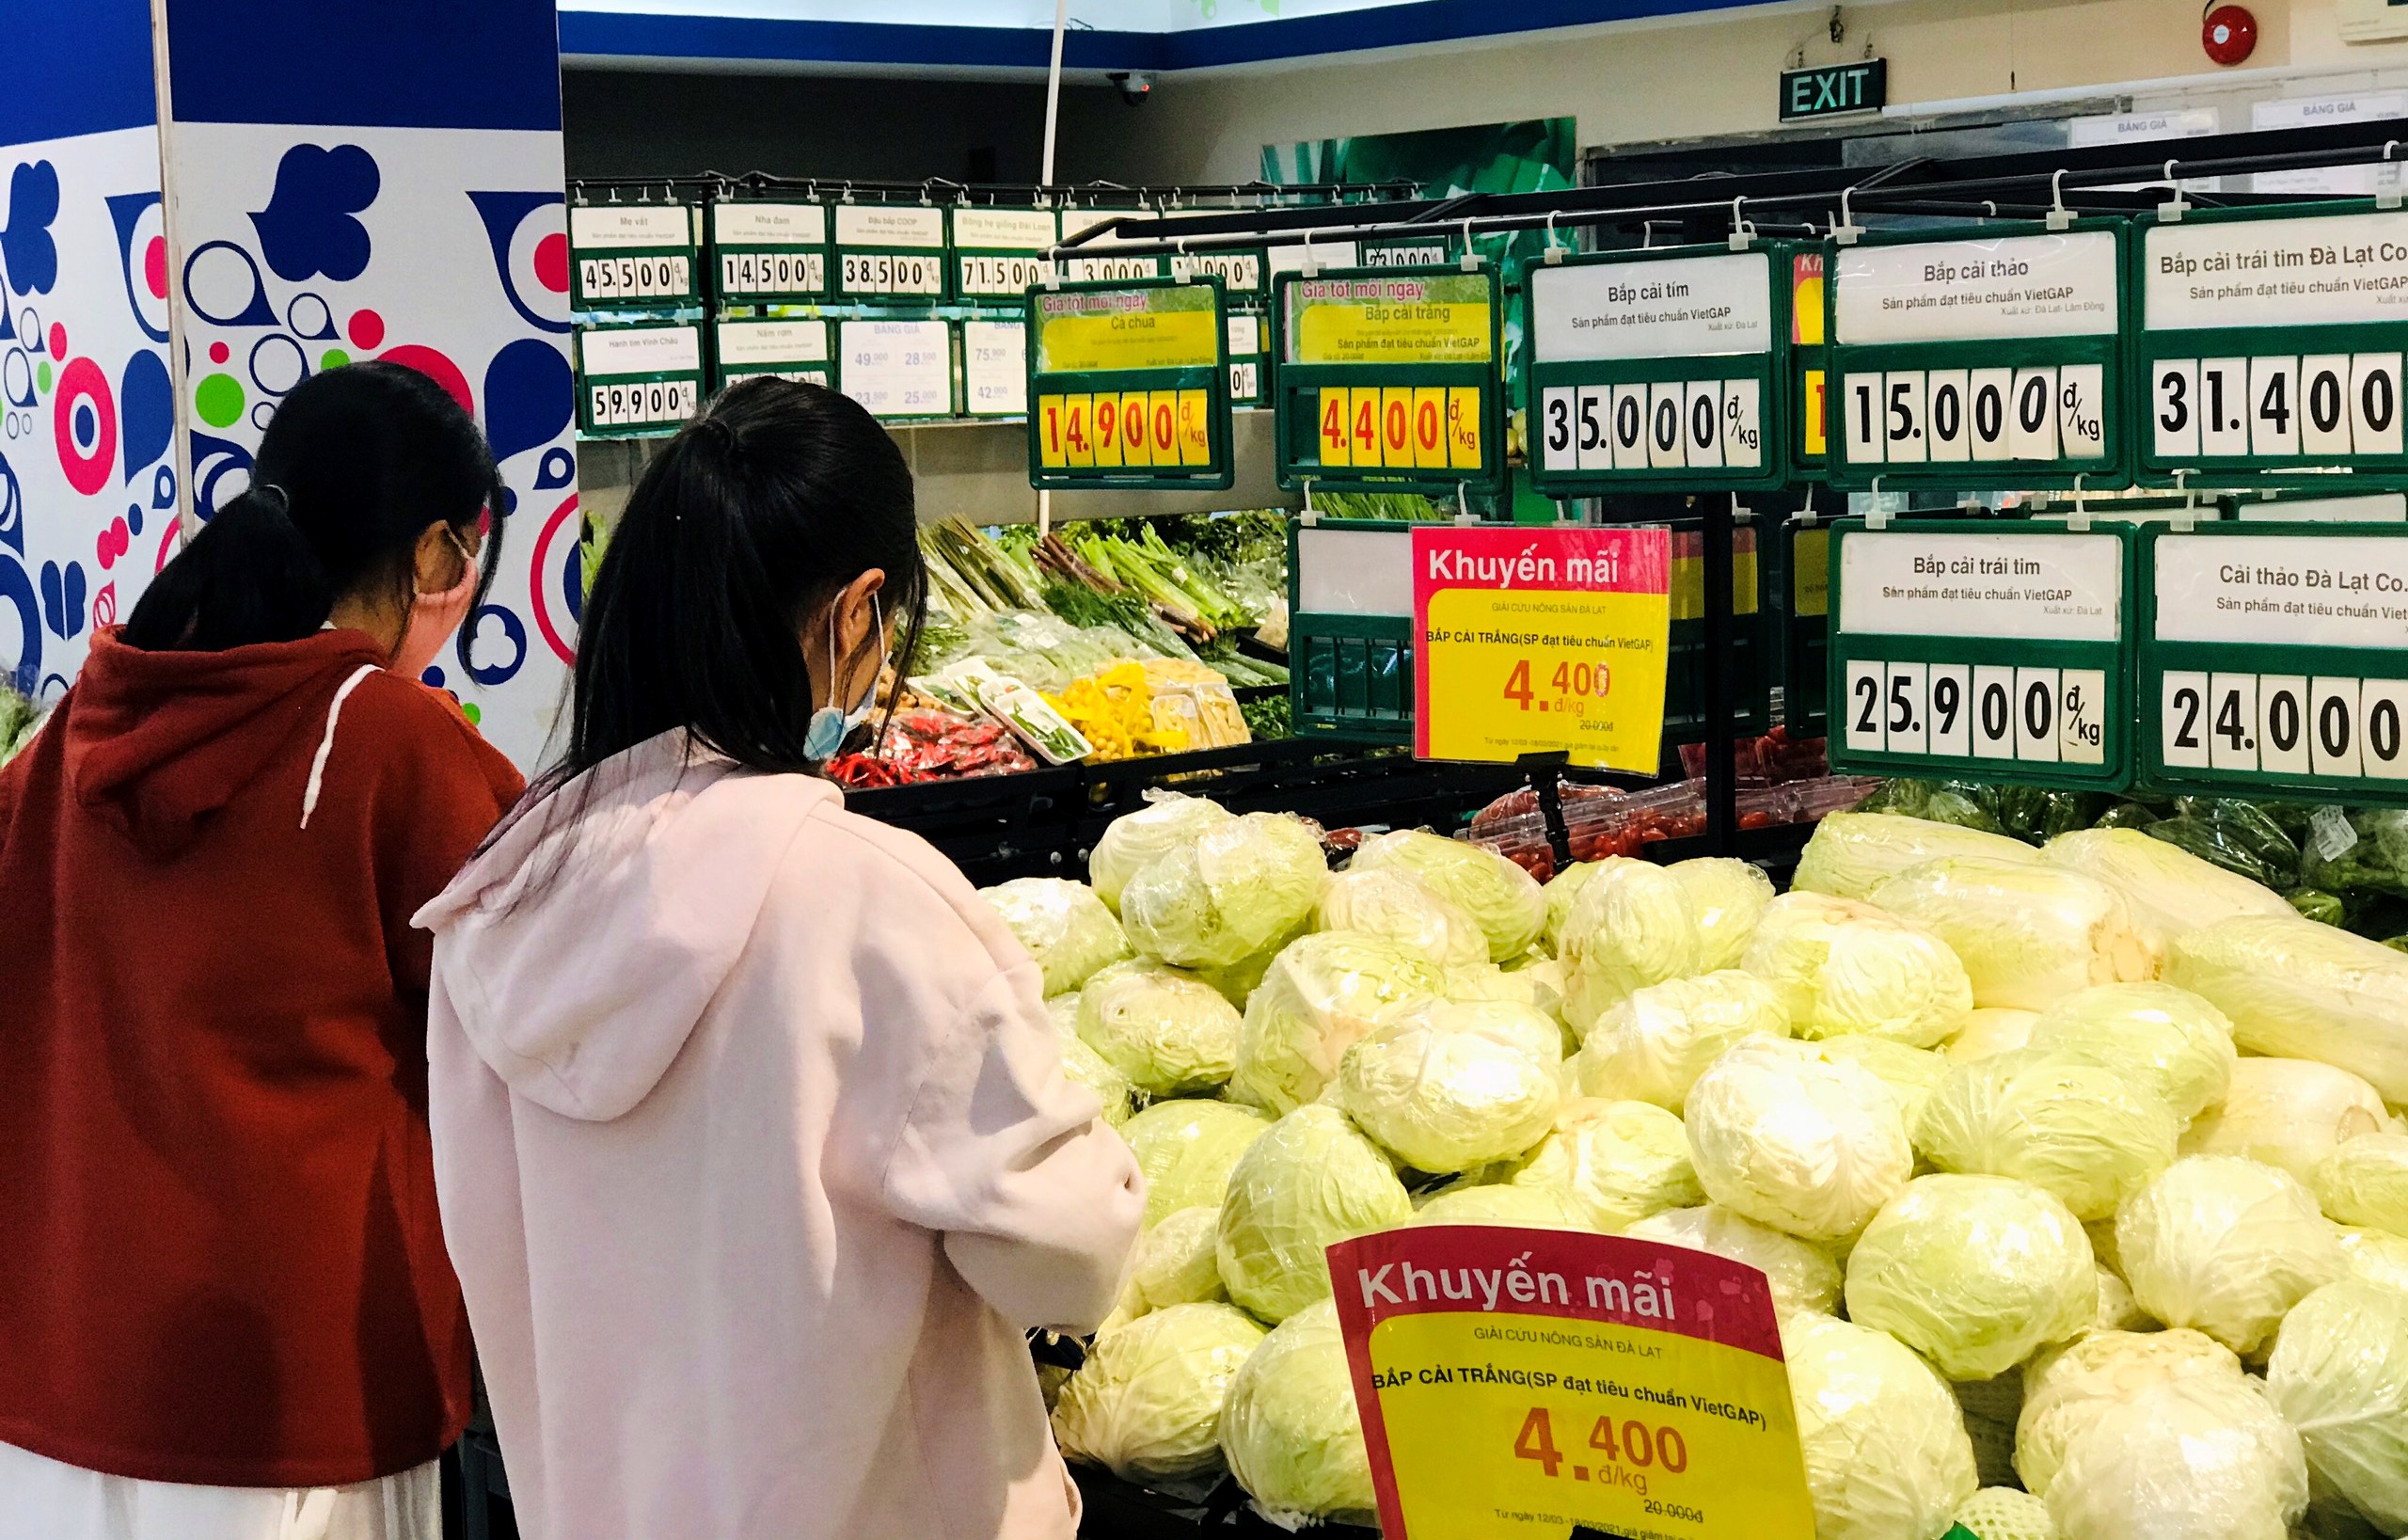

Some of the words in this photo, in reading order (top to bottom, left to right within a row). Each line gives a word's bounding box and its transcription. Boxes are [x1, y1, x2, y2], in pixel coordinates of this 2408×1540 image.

[1792, 68, 1869, 112] EXIT
[727, 259, 804, 283] 14.500
[846, 260, 922, 284] 38.500
[964, 262, 1038, 285] 71.500
[1925, 262, 1956, 284] Bắp
[1960, 260, 1986, 279] cải
[1990, 258, 2029, 277] thảo
[2161, 251, 2196, 277] Bắp
[2203, 252, 2230, 271] cải
[2236, 249, 2268, 269] trái
[2273, 249, 2304, 267] tim
[2310, 246, 2337, 265] Đà
[2343, 246, 2374, 268] Lạt
[586, 263, 670, 289] 45.500
[2190, 286, 2214, 299] Sản
[2217, 281, 2253, 300] phẩm
[2257, 284, 2277, 299] đạt
[2281, 281, 2305, 294] tiêu
[2308, 277, 2350, 294] chuẩn
[2353, 276, 2408, 291] VietGAP
[1608, 282, 1636, 305] Bắp
[1640, 282, 1662, 299] cải
[1666, 280, 1689, 297] tím
[1882, 296, 1904, 310] Sản
[1906, 293, 1937, 310] phẩm
[1940, 292, 1958, 309] đạt
[1960, 292, 1983, 305] tiêu
[1986, 287, 2021, 304] chuẩn
[2023, 286, 2074, 301] VietGAP
[1129, 316, 1155, 329] chua
[1572, 315, 1590, 328] Sản
[1592, 312, 1618, 329] phẩm
[1621, 311, 1636, 326] đạt
[1638, 311, 1656, 324] tiêu
[1659, 308, 1688, 323] chuẩn
[1690, 307, 1731, 321] VietGAP
[596, 387, 678, 416] 59.900
[1856, 376, 2047, 443] 15.000
[2063, 382, 2099, 441] đ/kg
[2161, 369, 2393, 434] 31.400
[1047, 402, 1172, 452] 14.900
[1181, 401, 1206, 447] đ/kg
[1323, 399, 1437, 450] 4.400
[1450, 398, 1476, 450] đ/kg
[1548, 393, 1714, 452] 35.000
[1727, 394, 1758, 450] đ/kg
[1429, 544, 1555, 588] Khuyến
[1567, 550, 1618, 583] mãi
[1913, 554, 1946, 578] Bắp
[1951, 556, 1974, 575] cải
[1979, 557, 2008, 575] trái
[2014, 558, 2040, 575] tim
[2220, 564, 2251, 584] Cải
[2256, 566, 2299, 587] thảo
[2305, 569, 2332, 588] Đà
[2339, 571, 2368, 595] Lạt
[1883, 586, 1905, 599] Sản
[1908, 584, 1939, 600] phẩm
[1941, 587, 1958, 602] đạt
[1961, 588, 1982, 600] tiêu
[1985, 585, 2020, 601] chuẩn
[2023, 589, 2072, 602] VietGAP
[1532, 602, 1559, 613] NÔNG
[2217, 595, 2241, 611] Sản
[2244, 596, 2280, 613] phẩm
[2284, 600, 2305, 617] đạt
[2307, 602, 2333, 616] tiêu
[2337, 602, 2378, 619] chuẩn
[1426, 627, 1450, 643] BẮP
[1454, 628, 1475, 643] CẢI
[1480, 628, 1539, 646] TRẮNG(SP
[1543, 635, 1560, 648] đạt
[1563, 635, 1582, 647] tiêu
[1504, 659, 1610, 711] 4.400
[1554, 698, 1584, 717] đ/kg
[1855, 675, 2052, 740] 25.900
[2067, 685, 2099, 746] đ/kg
[2173, 688, 2400, 761] 24.000
[1358, 1251, 1569, 1310] Khuyến
[1585, 1270, 1675, 1320] mãi
[1474, 1325, 1503, 1340] GIẢI
[1506, 1327, 1538, 1342] CỨU
[1541, 1330, 1583, 1347] NÔNG
[1586, 1334, 1614, 1352] SẢN
[1617, 1340, 1636, 1355] ĐÀ
[1371, 1367, 1413, 1389] BẮP
[1419, 1364, 1453, 1384] CẢI
[1457, 1363, 1558, 1389] TRẮNG(SP
[1563, 1376, 1592, 1395] đạt
[1596, 1379, 1629, 1398] tiêu
[1634, 1387, 1687, 1409] chuẩn
[1690, 1395, 1766, 1432] VietGAP)
[1513, 1406, 1687, 1482] 4.400
[1599, 1465, 1647, 1495] đ/kg
[1512, 1511, 1535, 1523] ngày
[1537, 1513, 1564, 1525] 12/03
[1643, 1499, 1704, 1524] 20.000đ
